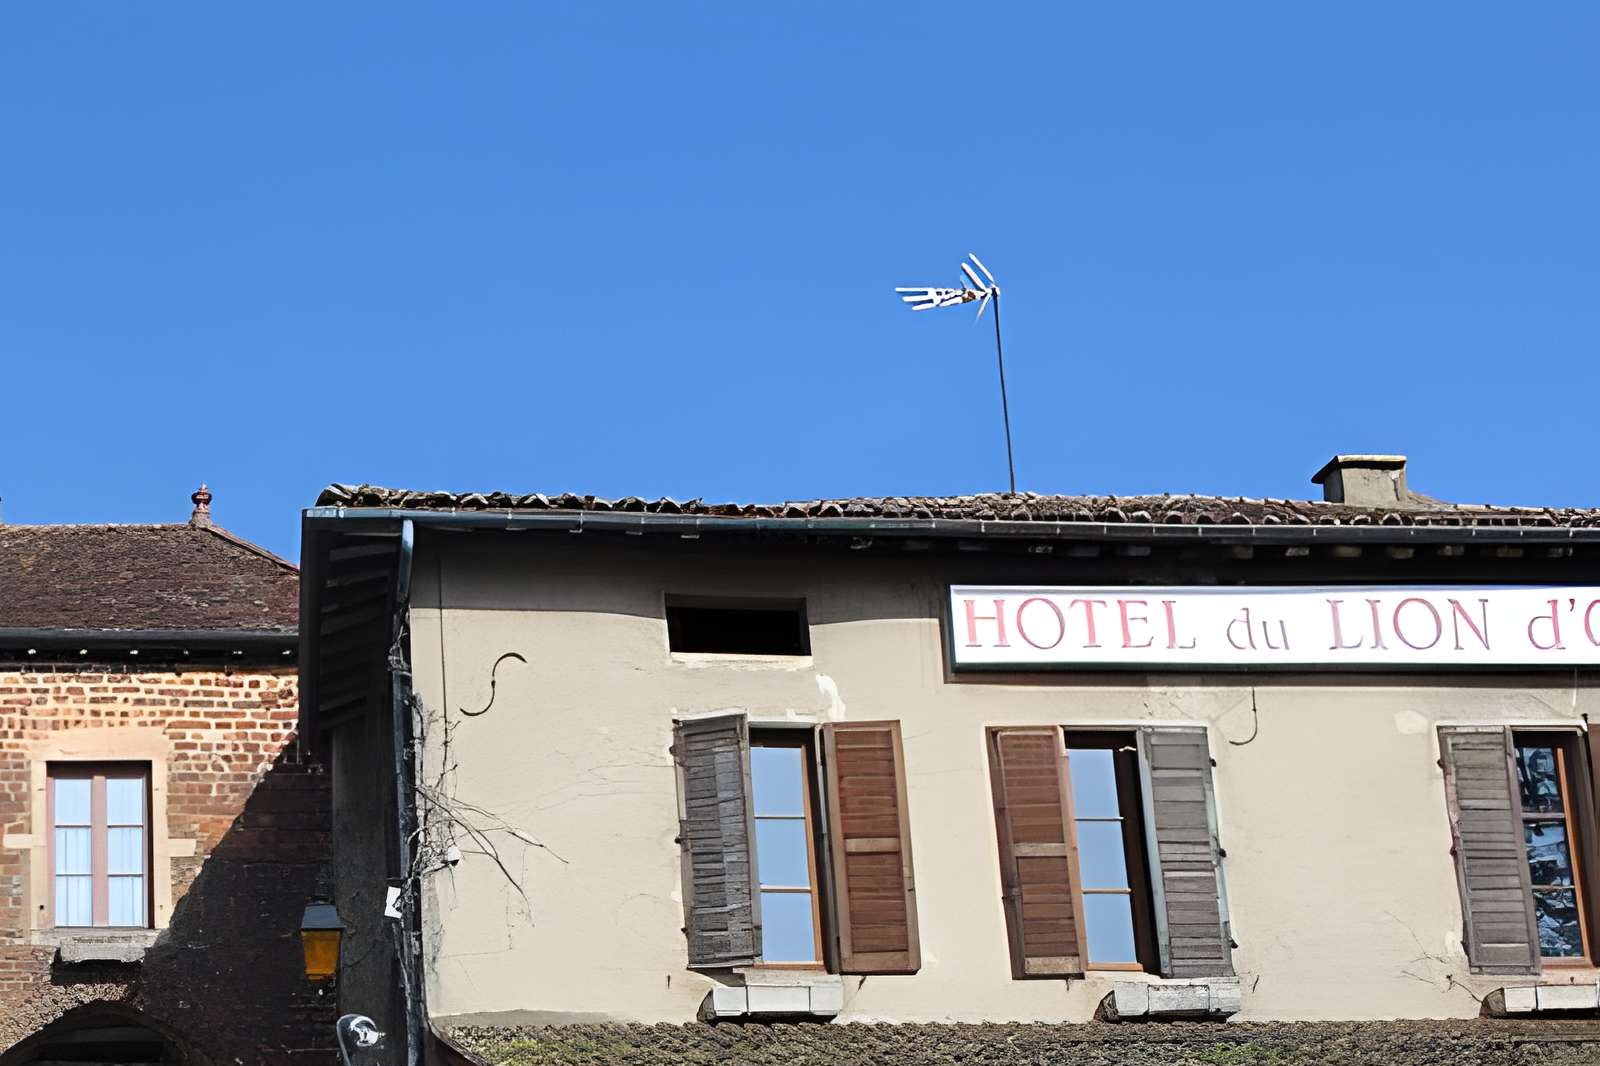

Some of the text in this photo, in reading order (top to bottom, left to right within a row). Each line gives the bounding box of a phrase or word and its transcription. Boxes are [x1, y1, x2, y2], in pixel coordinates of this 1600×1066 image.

[963, 596, 1197, 650] HOTEL
[1226, 607, 1291, 651] du
[1326, 596, 1490, 652] LION
